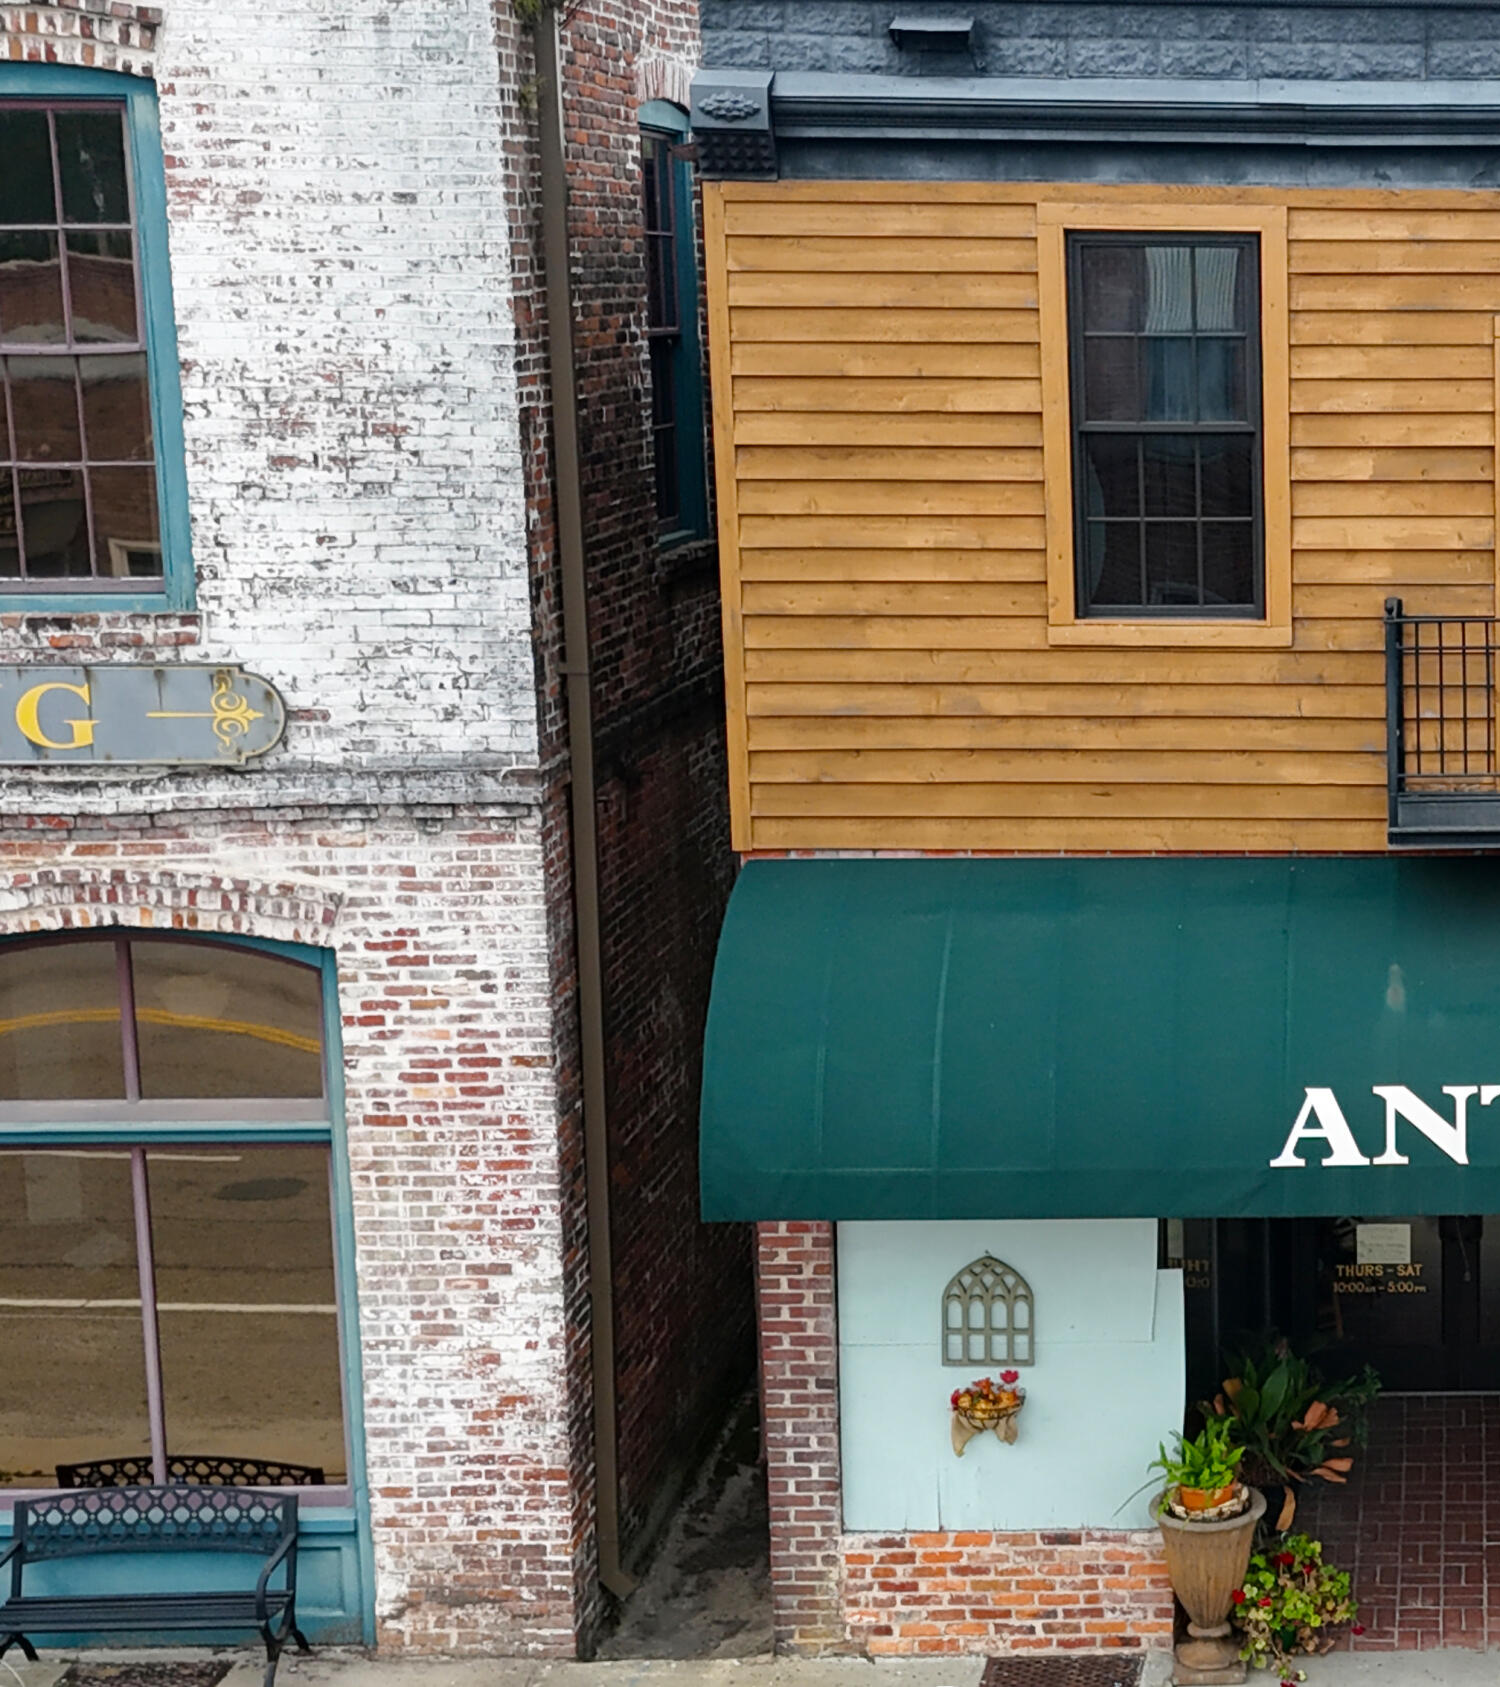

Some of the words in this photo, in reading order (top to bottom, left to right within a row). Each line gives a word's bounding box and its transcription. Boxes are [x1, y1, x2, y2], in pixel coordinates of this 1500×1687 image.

[0, 682, 100, 749] G
[1336, 1264, 1384, 1277] THURS
[1396, 1264, 1423, 1277] SAT
